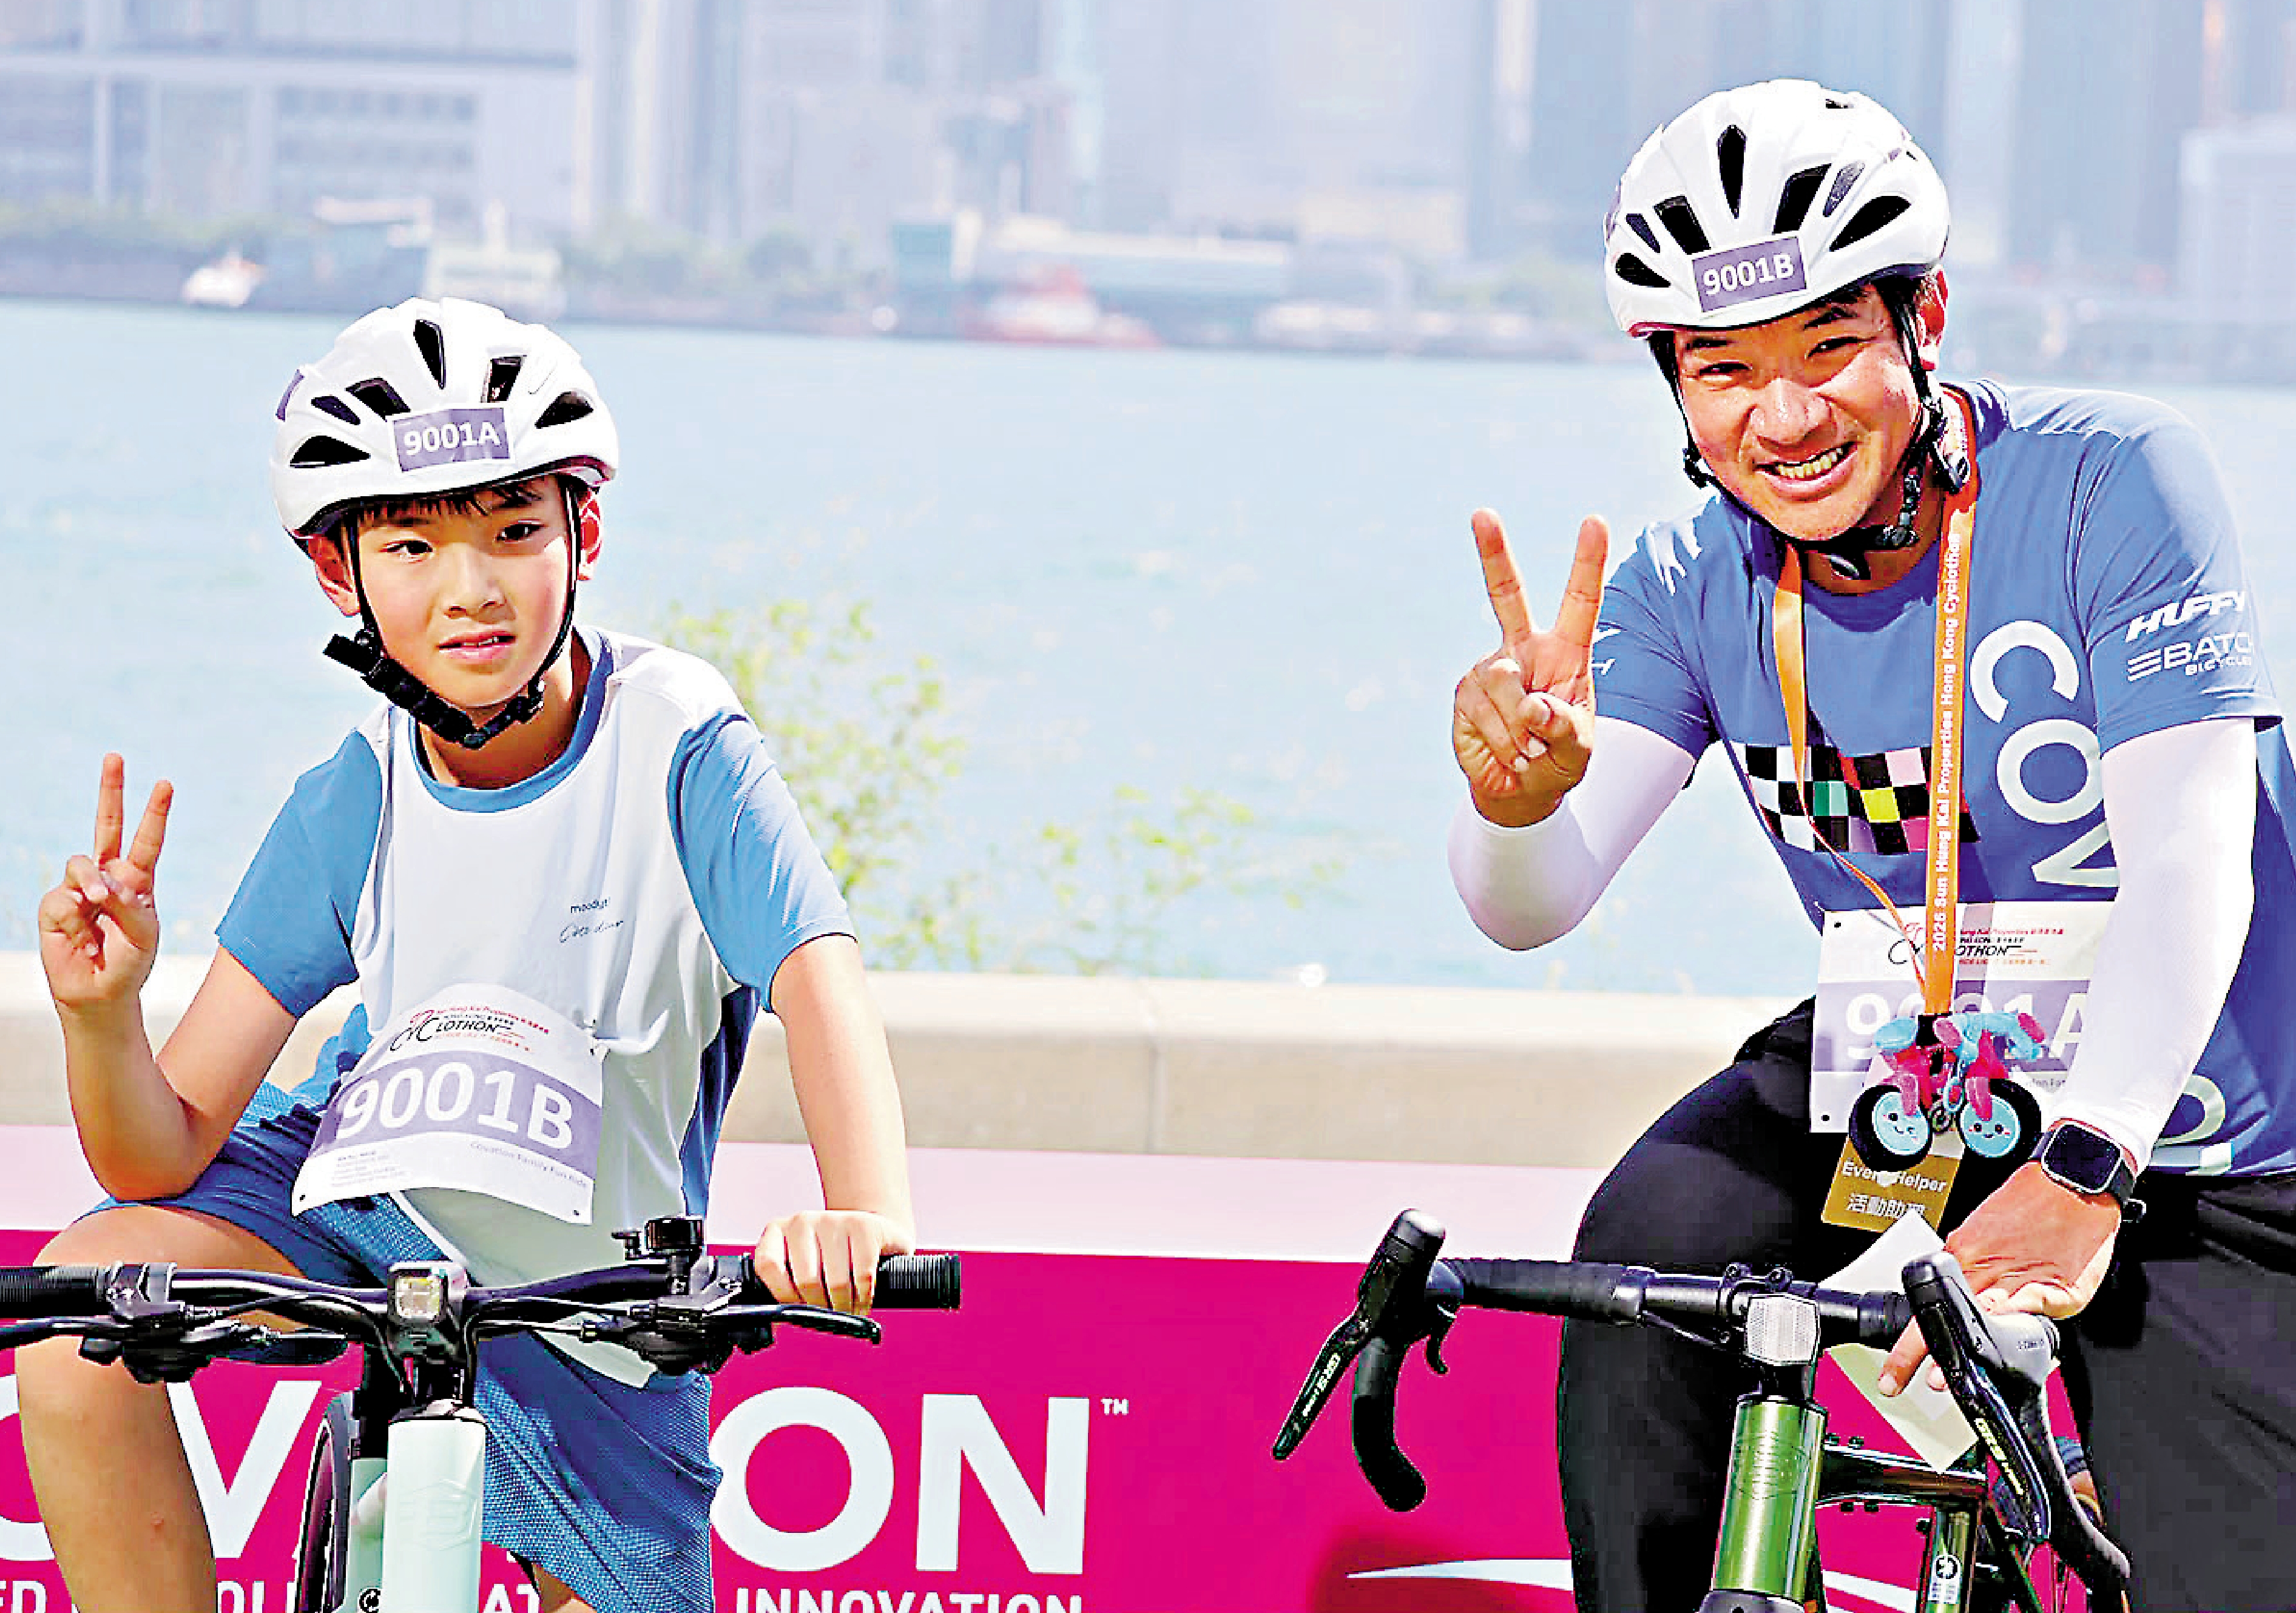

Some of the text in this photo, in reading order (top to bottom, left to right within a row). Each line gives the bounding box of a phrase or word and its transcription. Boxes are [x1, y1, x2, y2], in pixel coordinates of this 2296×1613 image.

[1704, 254, 1794, 295] 9001B
[403, 422, 501, 456] 9001A
[1943, 533, 1961, 614] Cyclothon
[1942, 618, 1959, 660] Kong
[1940, 664, 1957, 705] Hong
[1937, 710, 1954, 793] Properties
[1936, 799, 1950, 827] Kai
[1936, 830, 1951, 872] Hung
[1934, 878, 1948, 907] Sun
[337, 1061, 573, 1149] 9001B
